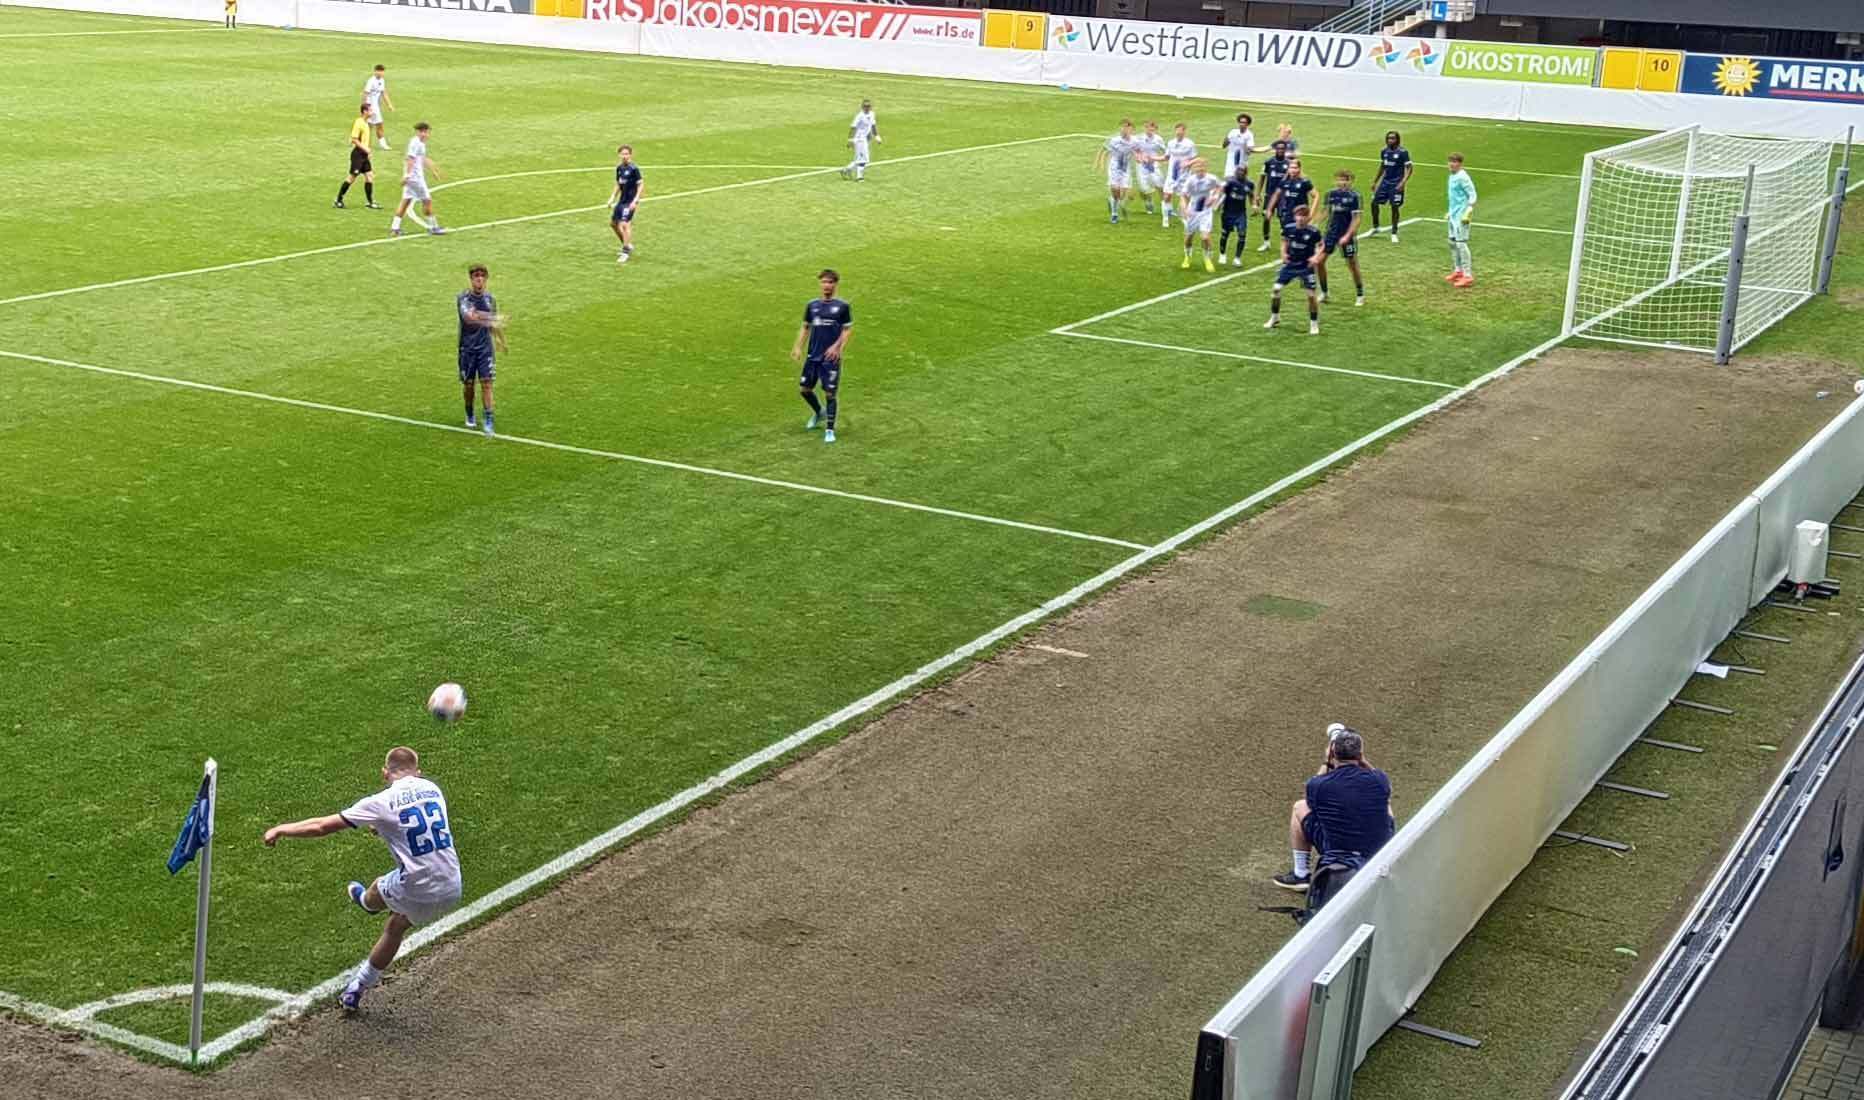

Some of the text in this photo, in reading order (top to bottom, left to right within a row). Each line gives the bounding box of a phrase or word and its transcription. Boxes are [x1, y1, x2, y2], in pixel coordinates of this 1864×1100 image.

[388, 0, 513, 13] ENA
[586, 0, 643, 22] RLS
[1434, 3, 1443, 17] L
[1026, 20, 1034, 31] 9
[1451, 46, 1591, 77] ÖKOSTROM!
[1652, 60, 1669, 72] 10
[399, 801, 451, 857] 22
